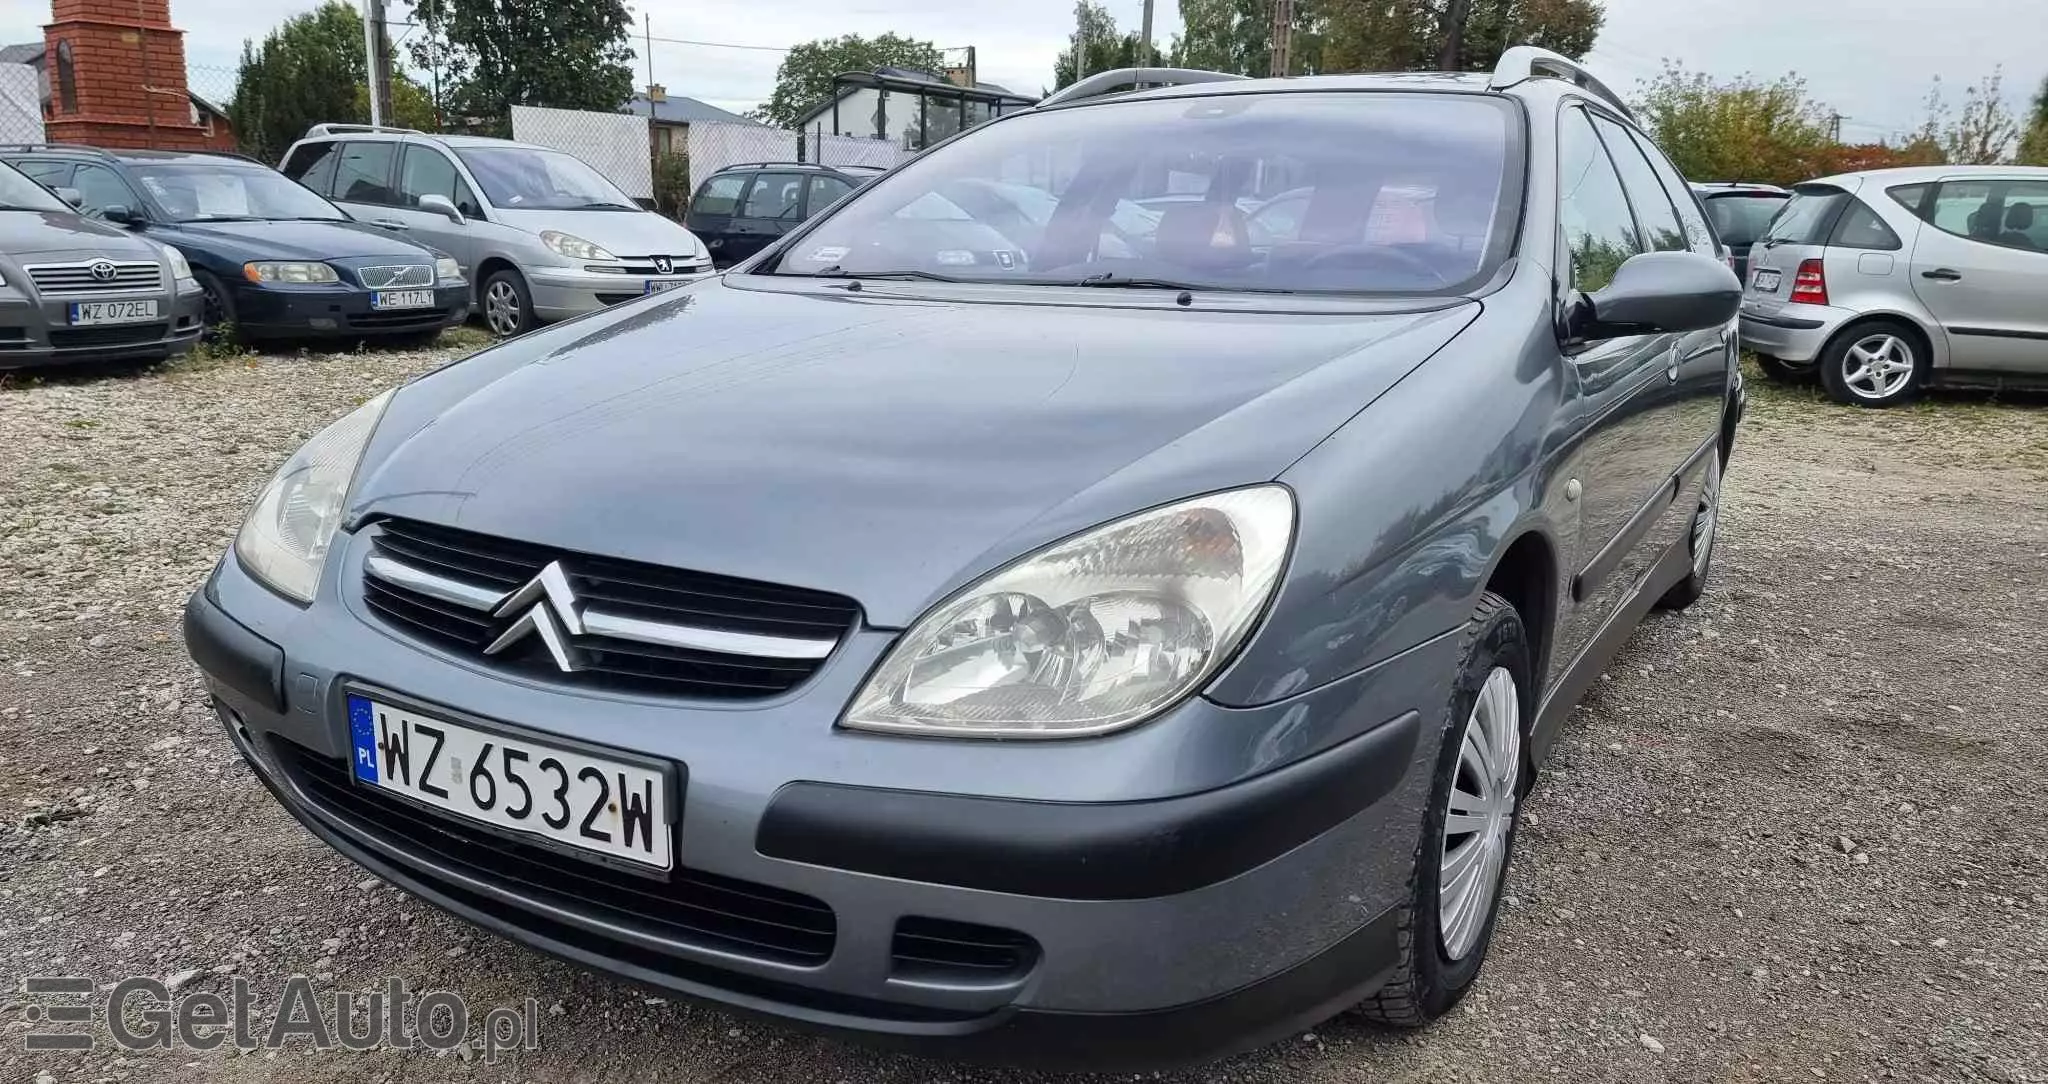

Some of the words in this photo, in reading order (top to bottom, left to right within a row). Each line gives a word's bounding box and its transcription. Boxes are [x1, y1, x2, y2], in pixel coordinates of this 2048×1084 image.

[380, 293, 396, 305] WE
[402, 291, 432, 304] 117LY
[81, 304, 102, 319] WZ
[108, 302, 153, 318] 072EL
[359, 748, 375, 768] PL
[380, 713, 449, 799] WZ
[469, 742, 652, 852] 6532W
